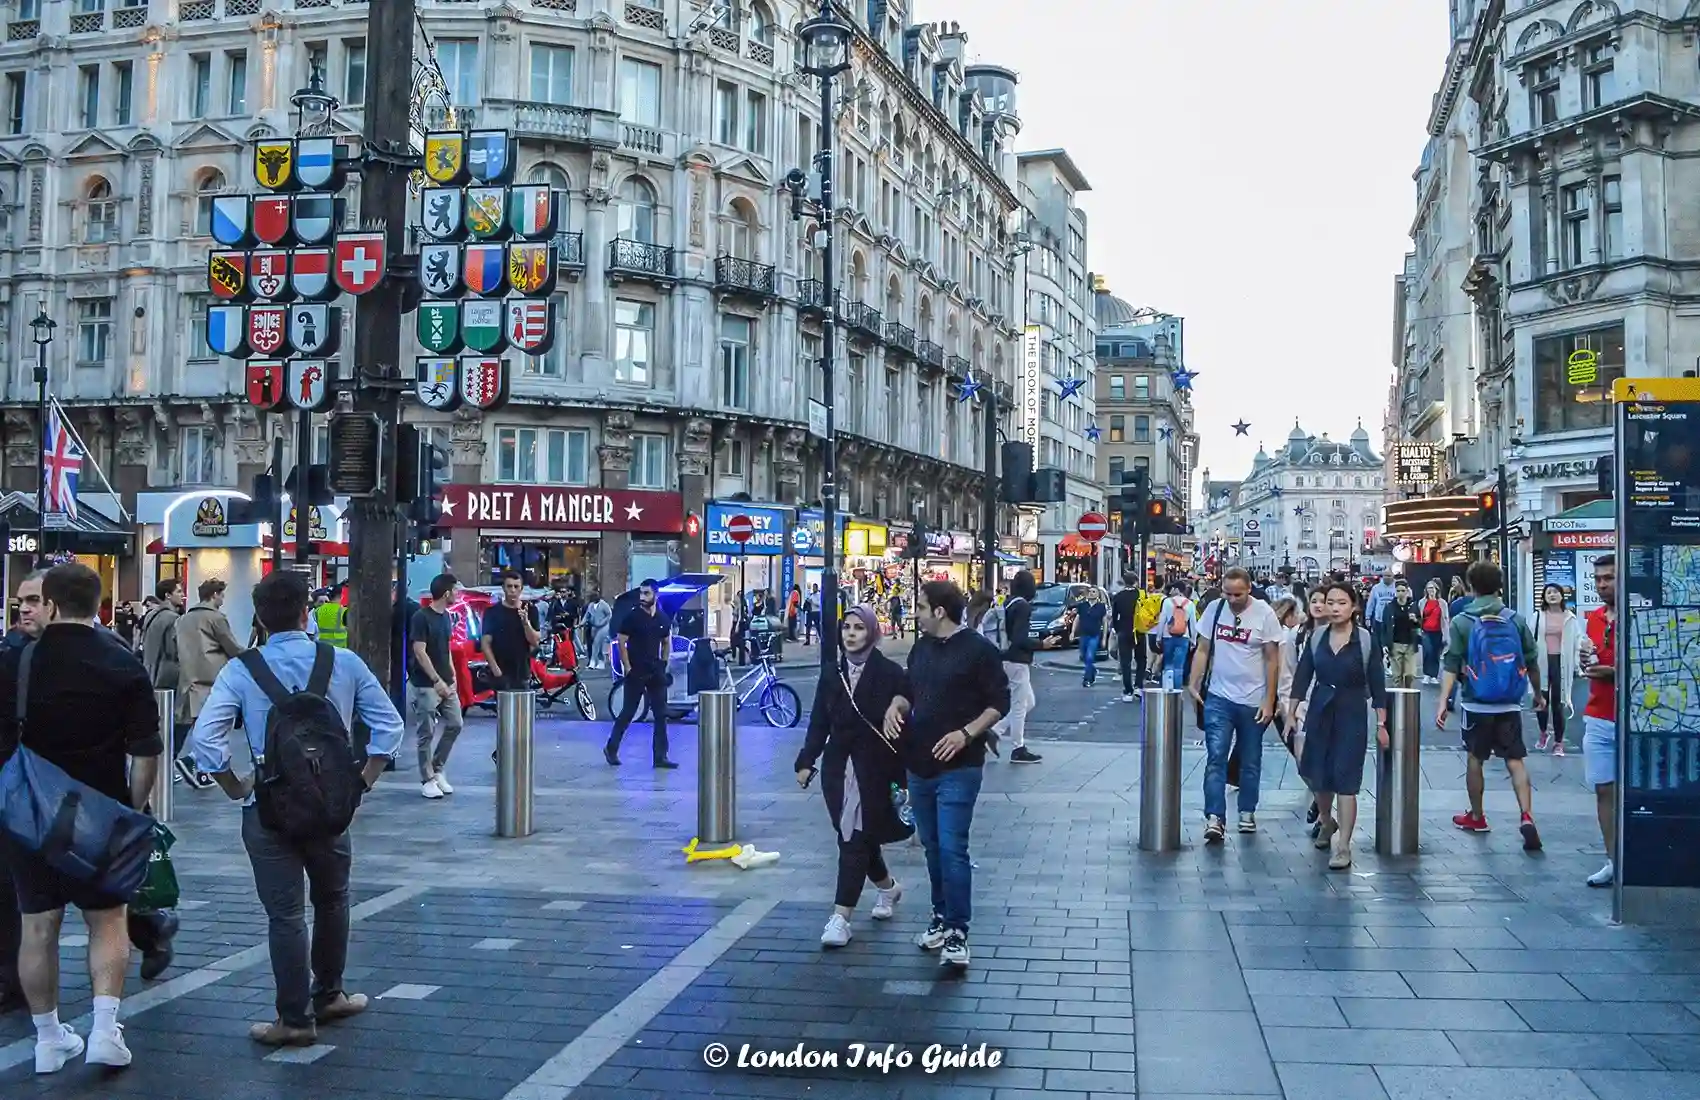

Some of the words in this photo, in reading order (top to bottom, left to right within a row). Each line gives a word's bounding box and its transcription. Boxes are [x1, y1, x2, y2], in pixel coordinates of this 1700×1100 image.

[1028, 336, 1037, 357] THE
[1028, 361, 1037, 395] BOOK
[1027, 398, 1036, 414] OF
[1662, 412, 1687, 420] Square
[1401, 446, 1431, 458] RIALTO
[1401, 458, 1430, 466] BACKSTAGE
[468, 491, 514, 520] PRET
[520, 492, 533, 521] A
[540, 492, 614, 523] MANGER
[721, 513, 772, 530] MNEY
[8, 534, 37, 552] stle
[709, 530, 784, 546] EXCANGE
[1557, 534, 1577, 545] Let
[1578, 534, 1616, 545] Londo
